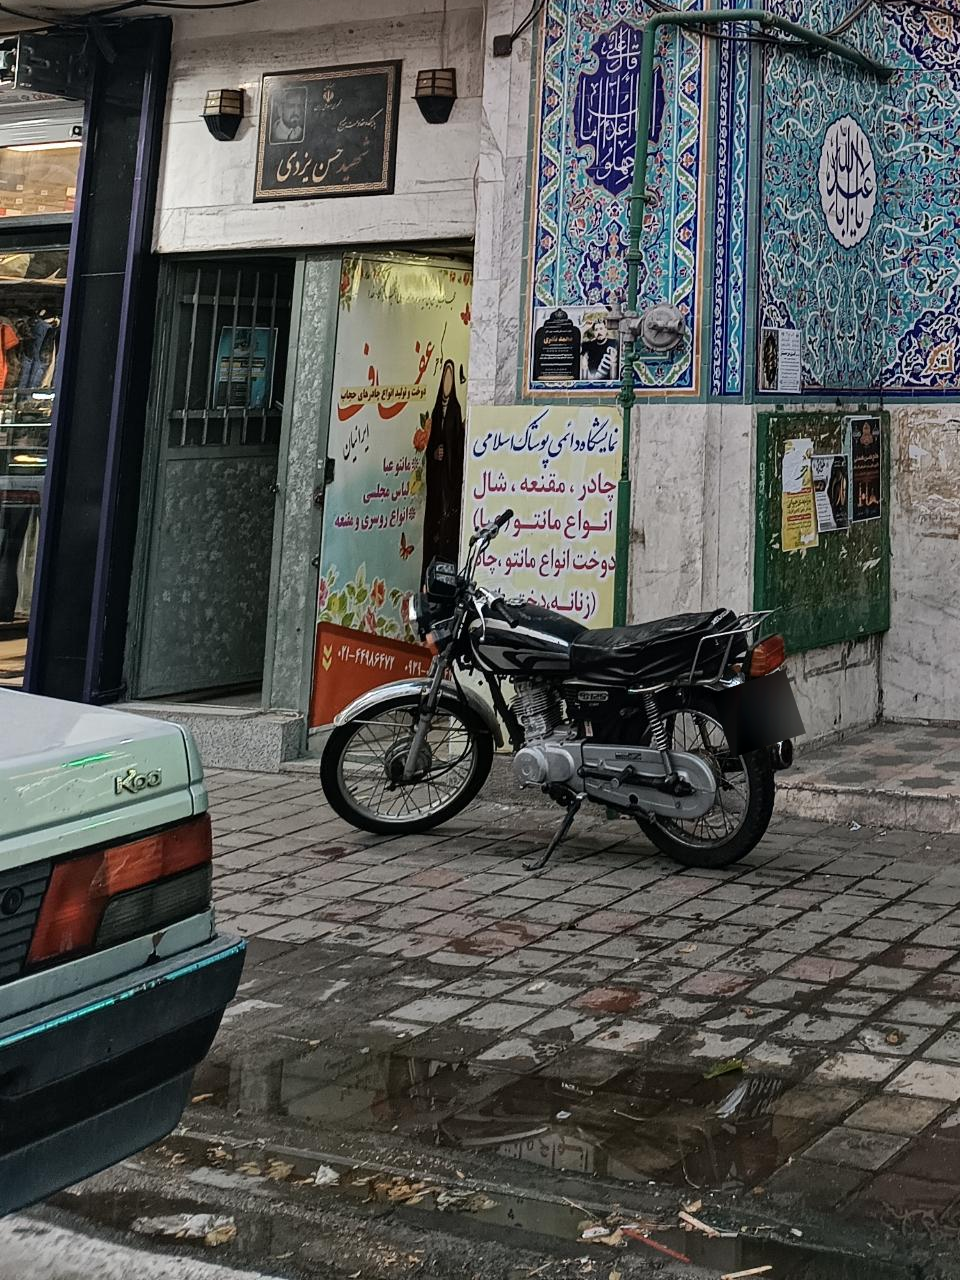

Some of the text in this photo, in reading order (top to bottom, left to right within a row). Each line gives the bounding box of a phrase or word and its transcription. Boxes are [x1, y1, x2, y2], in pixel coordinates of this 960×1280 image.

[276, 136, 370, 183] شهید حسن یزدی
[340, 389, 357, 400] حجاب
[381, 387, 395, 401] انواع
[411, 387, 427, 400] دوخت
[343, 423, 370, 463] ایرانیان
[473, 432, 514, 457] اسلامی
[548, 421, 579, 458] دائمی
[578, 416, 619, 453] نمایشگاه
[383, 456, 411, 476] مانتو عبا
[391, 481, 410, 501] لباس
[473, 470, 617, 502] چادر مقنعه شال
[354, 516, 360, 531] و
[361, 514, 388, 530] روسری
[389, 507, 409, 527] انواع
[513, 508, 612, 539] انواع مانتو
[504, 547, 536, 576] مانتو
[539, 548, 570, 577] انواع
[573, 550, 616, 578] دوخت
